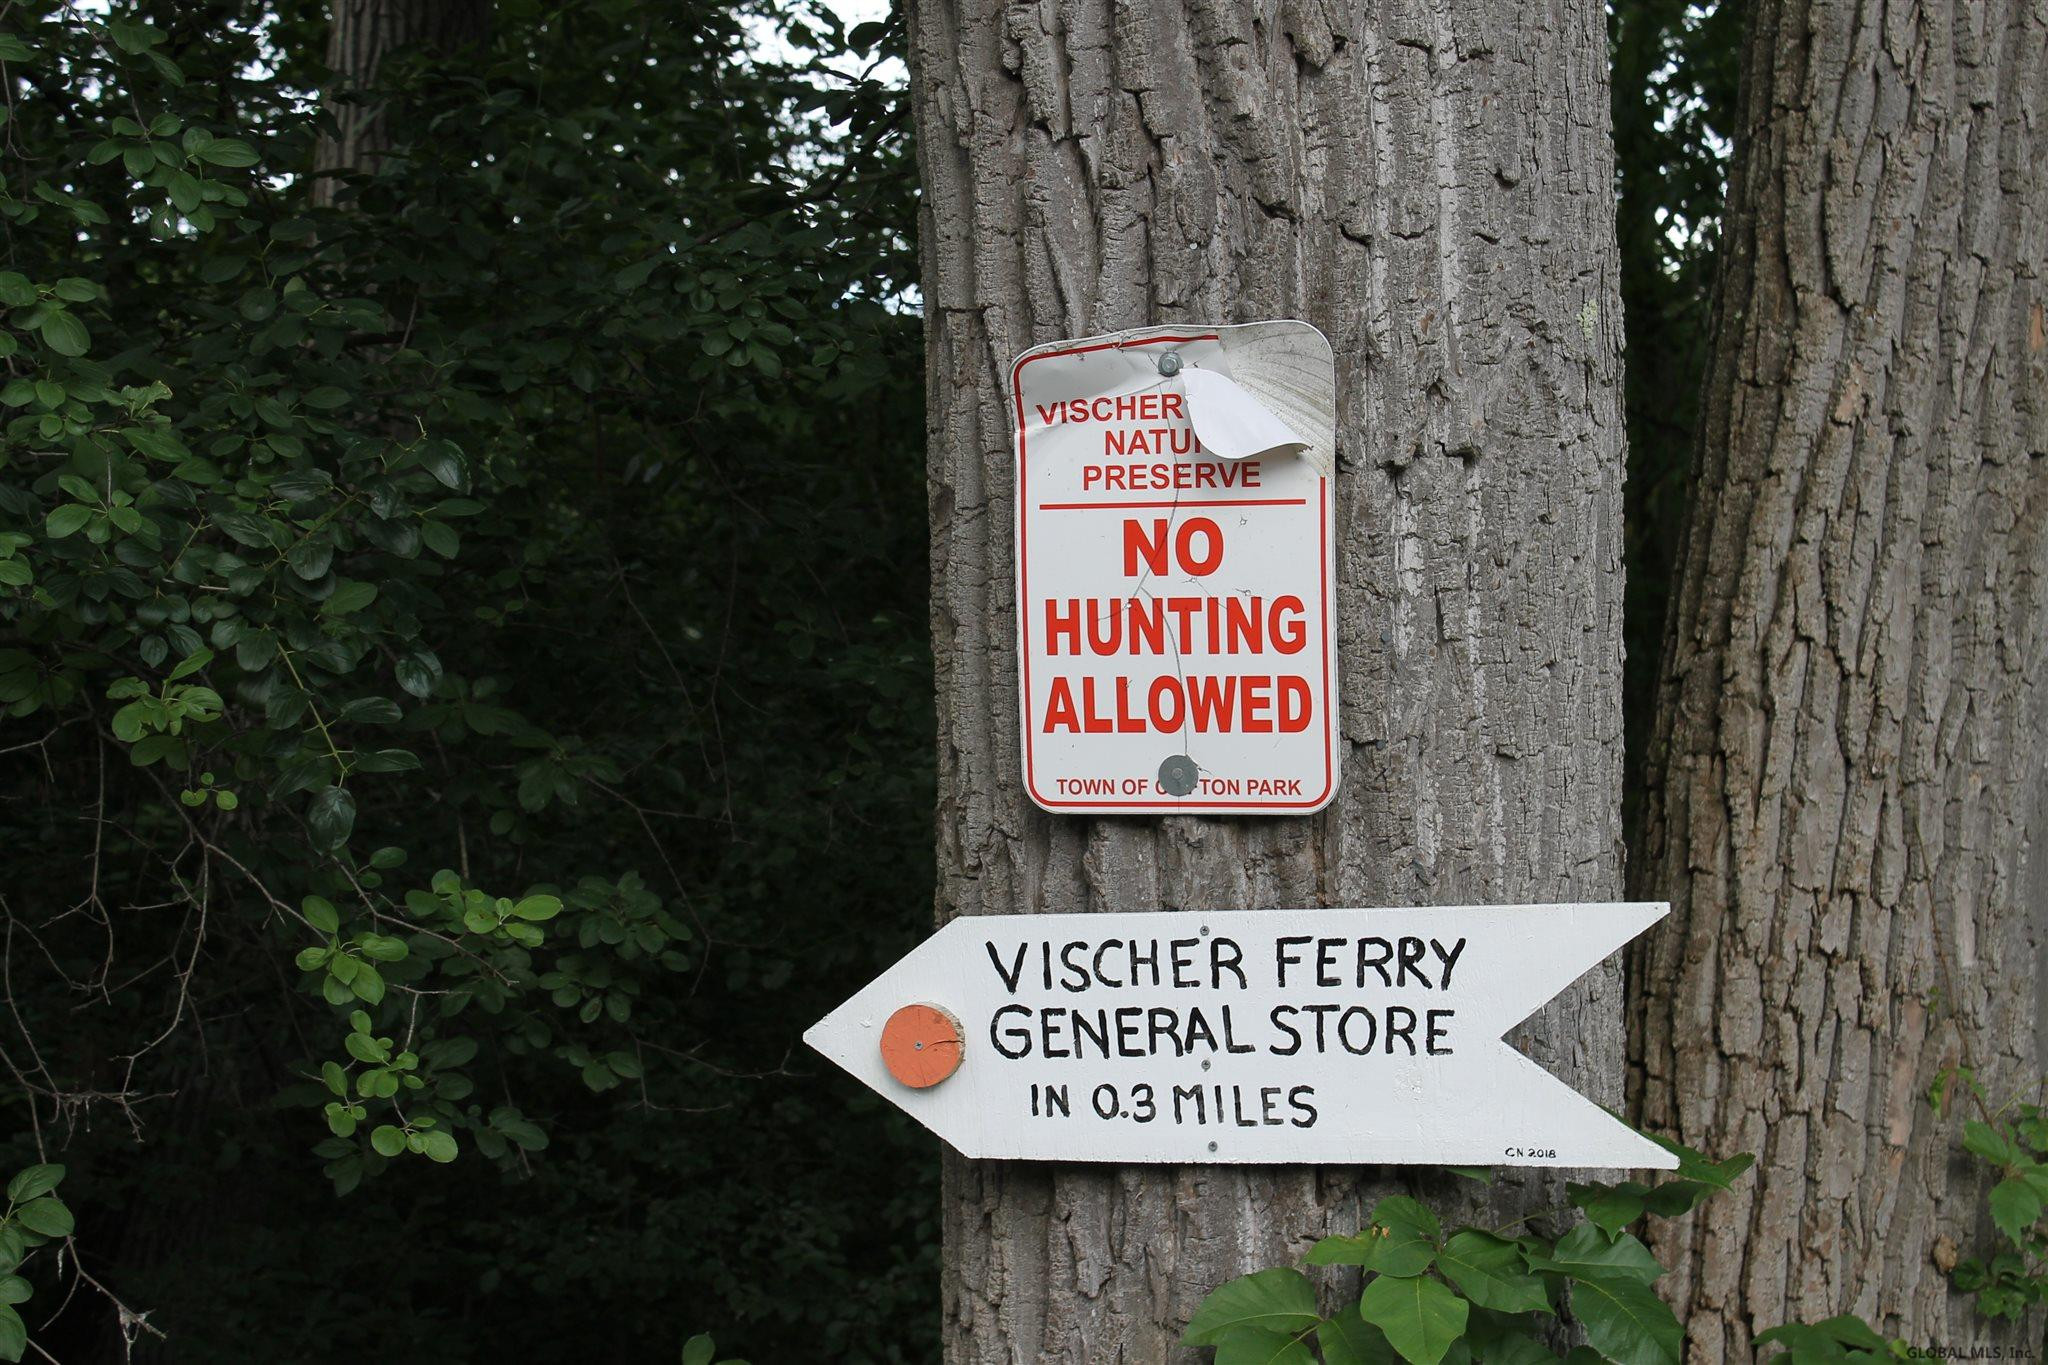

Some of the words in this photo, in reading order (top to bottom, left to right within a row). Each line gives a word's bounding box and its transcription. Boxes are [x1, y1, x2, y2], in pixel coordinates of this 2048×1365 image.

[1036, 393, 1184, 425] VISCHER
[1105, 428, 1200, 456] NATU
[1083, 461, 1261, 491] PRESERVE
[1123, 517, 1225, 577] NO
[1045, 595, 1307, 656] HUNTING
[1042, 675, 1312, 733] ALLOWED
[1056, 779, 1114, 795] TOWN
[1121, 779, 1149, 795] OF
[1247, 779, 1302, 795] PARK
[985, 937, 1248, 994] VISCHER
[1276, 936, 1467, 990] FERRY
[990, 1004, 1256, 1060] GENERAL
[1269, 1004, 1455, 1056] STORE
[1030, 1083, 1071, 1118] IN
[1092, 1083, 1157, 1124] 0.3
[1173, 1084, 1319, 1129] MILES
[1505, 1147, 1524, 1158] CN
[1528, 1148, 1557, 1159] 2018
